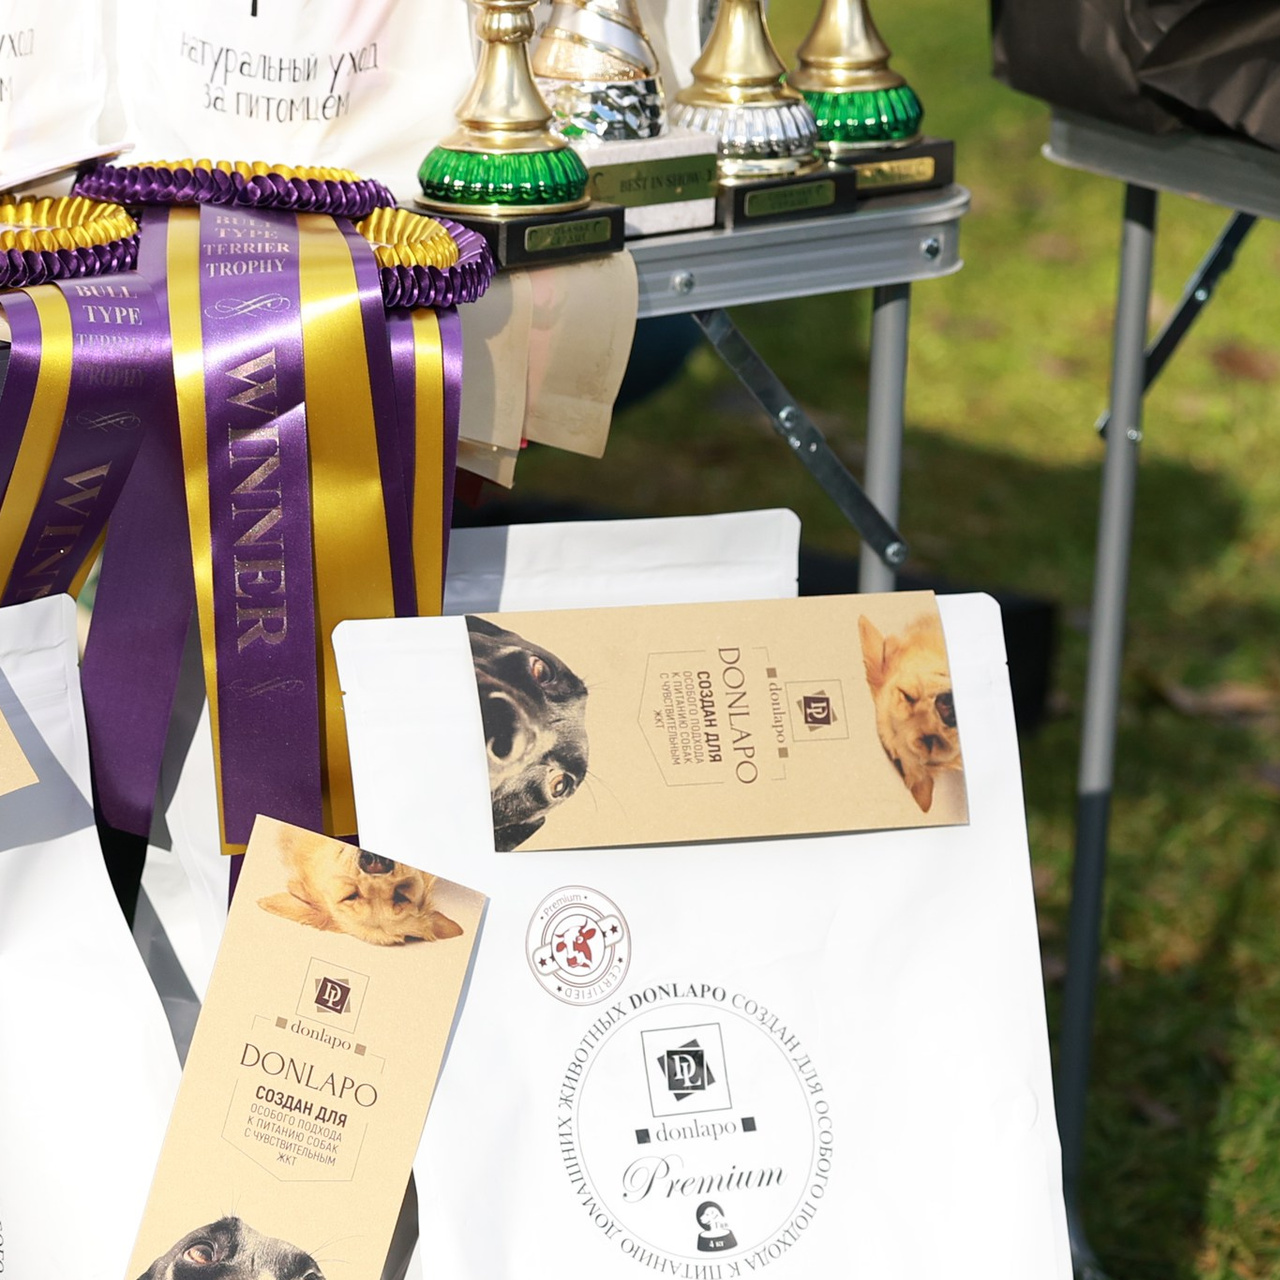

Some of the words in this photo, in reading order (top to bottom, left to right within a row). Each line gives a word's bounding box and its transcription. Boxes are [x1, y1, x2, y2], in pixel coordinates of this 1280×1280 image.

[328, 42, 378, 94] уход
[203, 83, 226, 112] за
[236, 92, 350, 122] питомцем
[650, 176, 662, 188] IN
[203, 242, 291, 255] TERRIER
[216, 228, 278, 239] TYPE
[205, 258, 287, 278] TROPHY
[75, 285, 138, 298] BULL
[82, 305, 143, 326] TYPE
[225, 347, 288, 654] WINNER
[653, 710, 665, 729] ЖКТ
[682, 670, 698, 716] ОСОБОГО
[691, 718, 704, 764] ПОДХОДА
[697, 671, 718, 728] СОЗДАН
[718, 647, 759, 784] DONLAPO
[769, 682, 786, 743] donlapo
[661, 681, 681, 766] ЧУВСТВИТЕЛЬНЫМ
[673, 681, 688, 729] ПИТАНИЮ
[681, 733, 693, 764] СОБАК
[704, 732, 723, 763] ДЛЯ
[543, 894, 582, 916] Premium
[564, 965, 621, 999] CERTIFIED
[629, 983, 727, 1010] DONLAPO
[290, 1020, 351, 1050] donlapo
[731, 993, 802, 1054] СОЗДАН
[240, 1043, 378, 1108] DONLAPO
[558, 1002, 627, 1110] ЖИВОТНЫХ
[791, 1054, 825, 1096] ДЛЯ
[250, 1103, 295, 1126] ОСОБОГО
[297, 1117, 343, 1143] ПОДХОДА
[255, 1085, 314, 1116] СОЗДАН
[314, 1106, 348, 1128] ДЛЯ
[244, 1128, 250, 1137] С
[252, 1129, 336, 1167] ЧУВСТВИТЕЛЬНЫМ
[247, 1116, 254, 1125] К
[256, 1118, 305, 1143] ПИТАНИЮ
[306, 1135, 338, 1154] СОБАК
[655, 1118, 737, 1143] donlapo
[813, 1100, 834, 1200] ОСОБОГО
[276, 1152, 297, 1166] ЖКТ
[557, 1115, 623, 1241] ДОМАШНИХ
[622, 1153, 788, 1203] Premium
[620, 1237, 723, 1280] ПИТАНИЮ
[744, 1199, 818, 1277] ПОДХОДА
